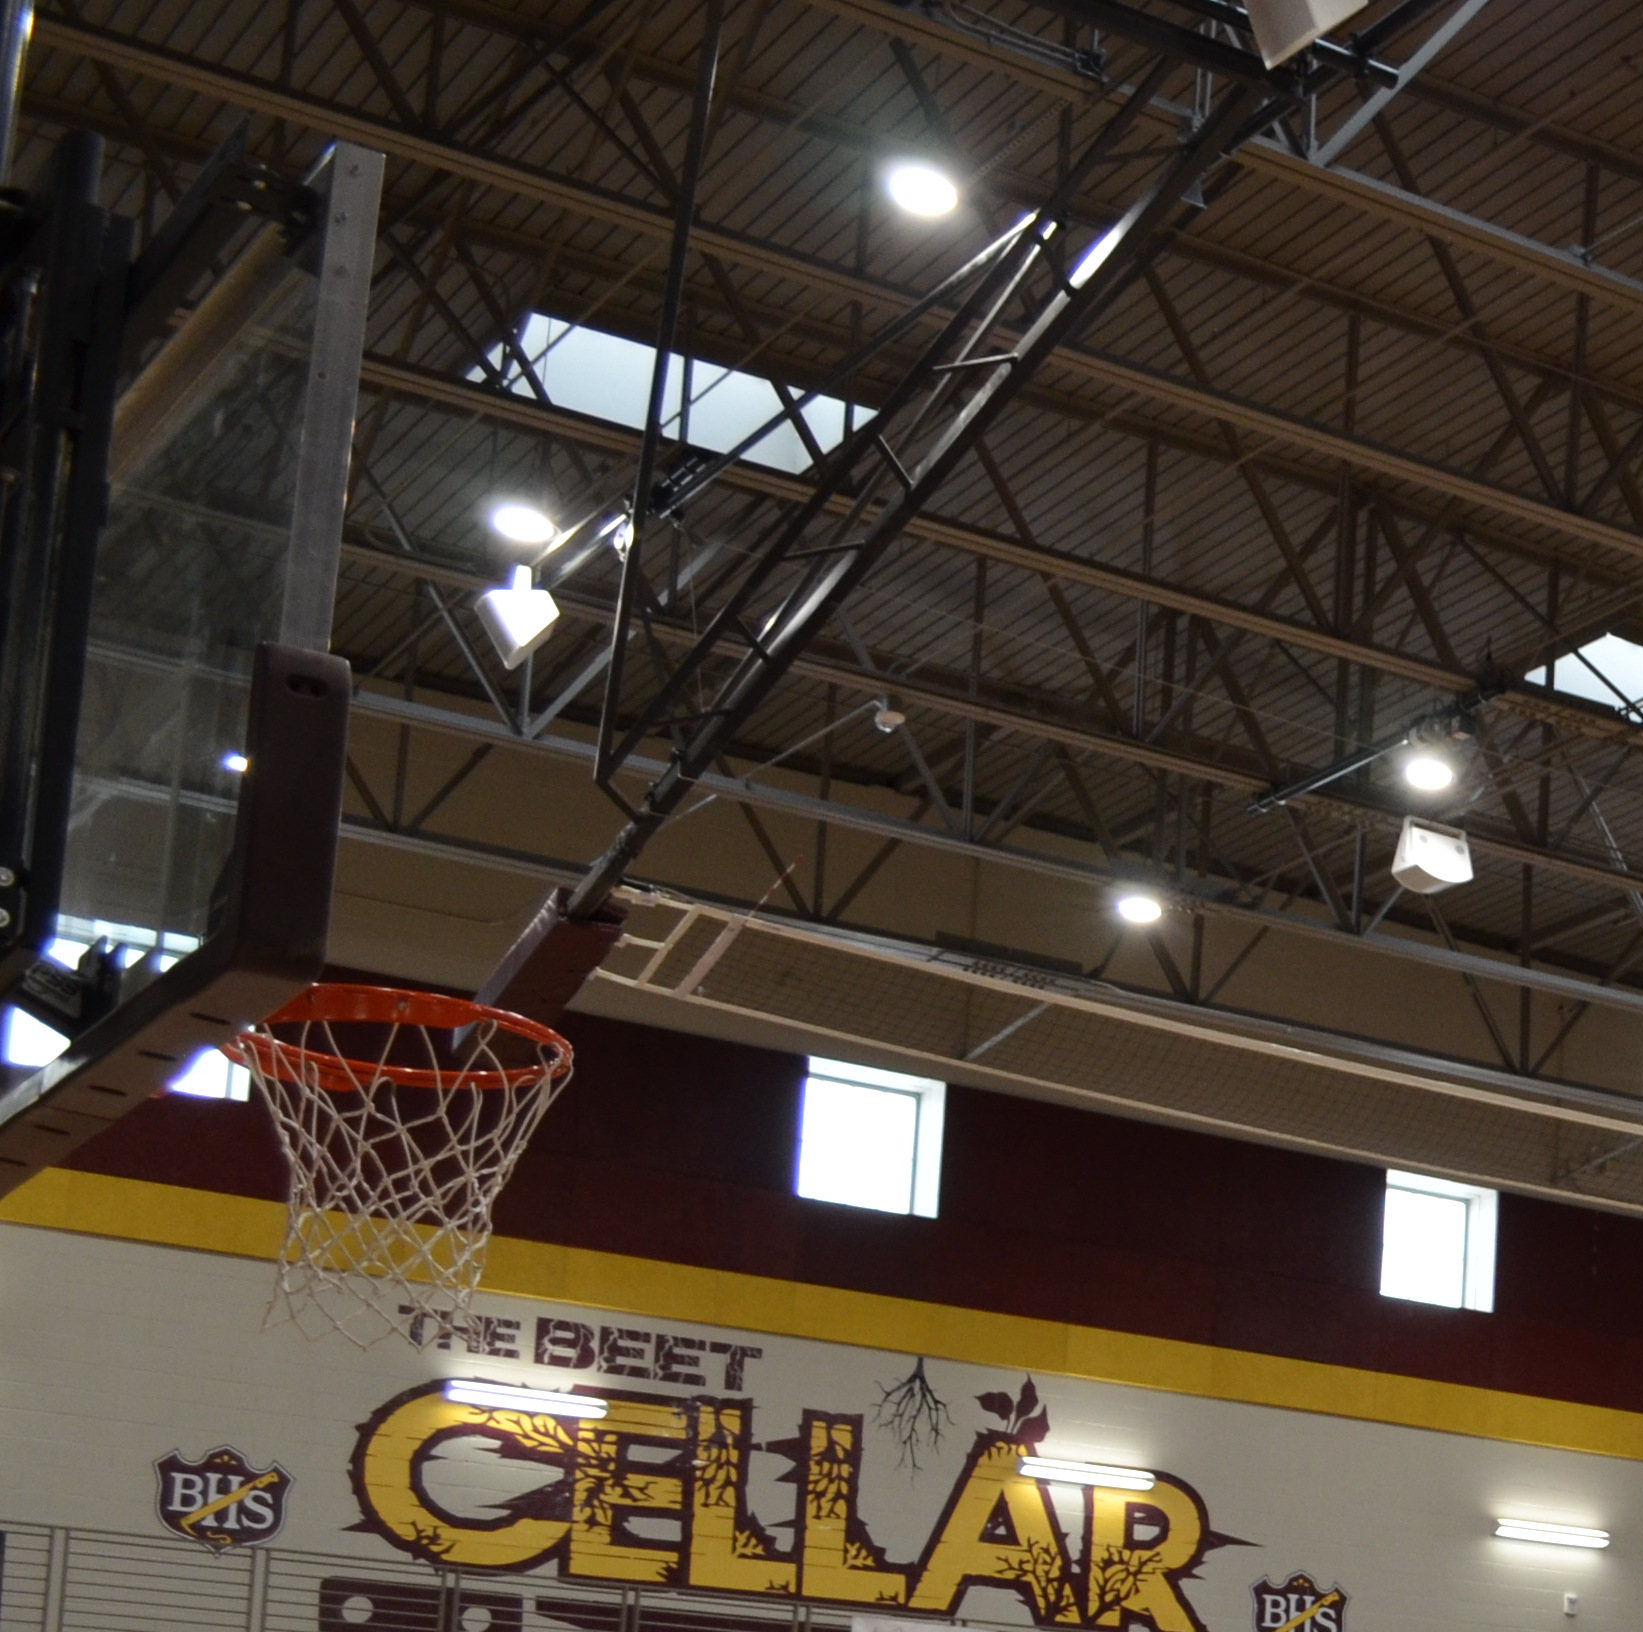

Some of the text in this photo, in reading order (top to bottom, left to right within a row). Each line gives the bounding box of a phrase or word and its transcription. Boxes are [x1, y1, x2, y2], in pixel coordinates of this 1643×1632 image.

[398, 1304, 763, 1392] THE BEET
[166, 1471, 276, 1531] BHS
